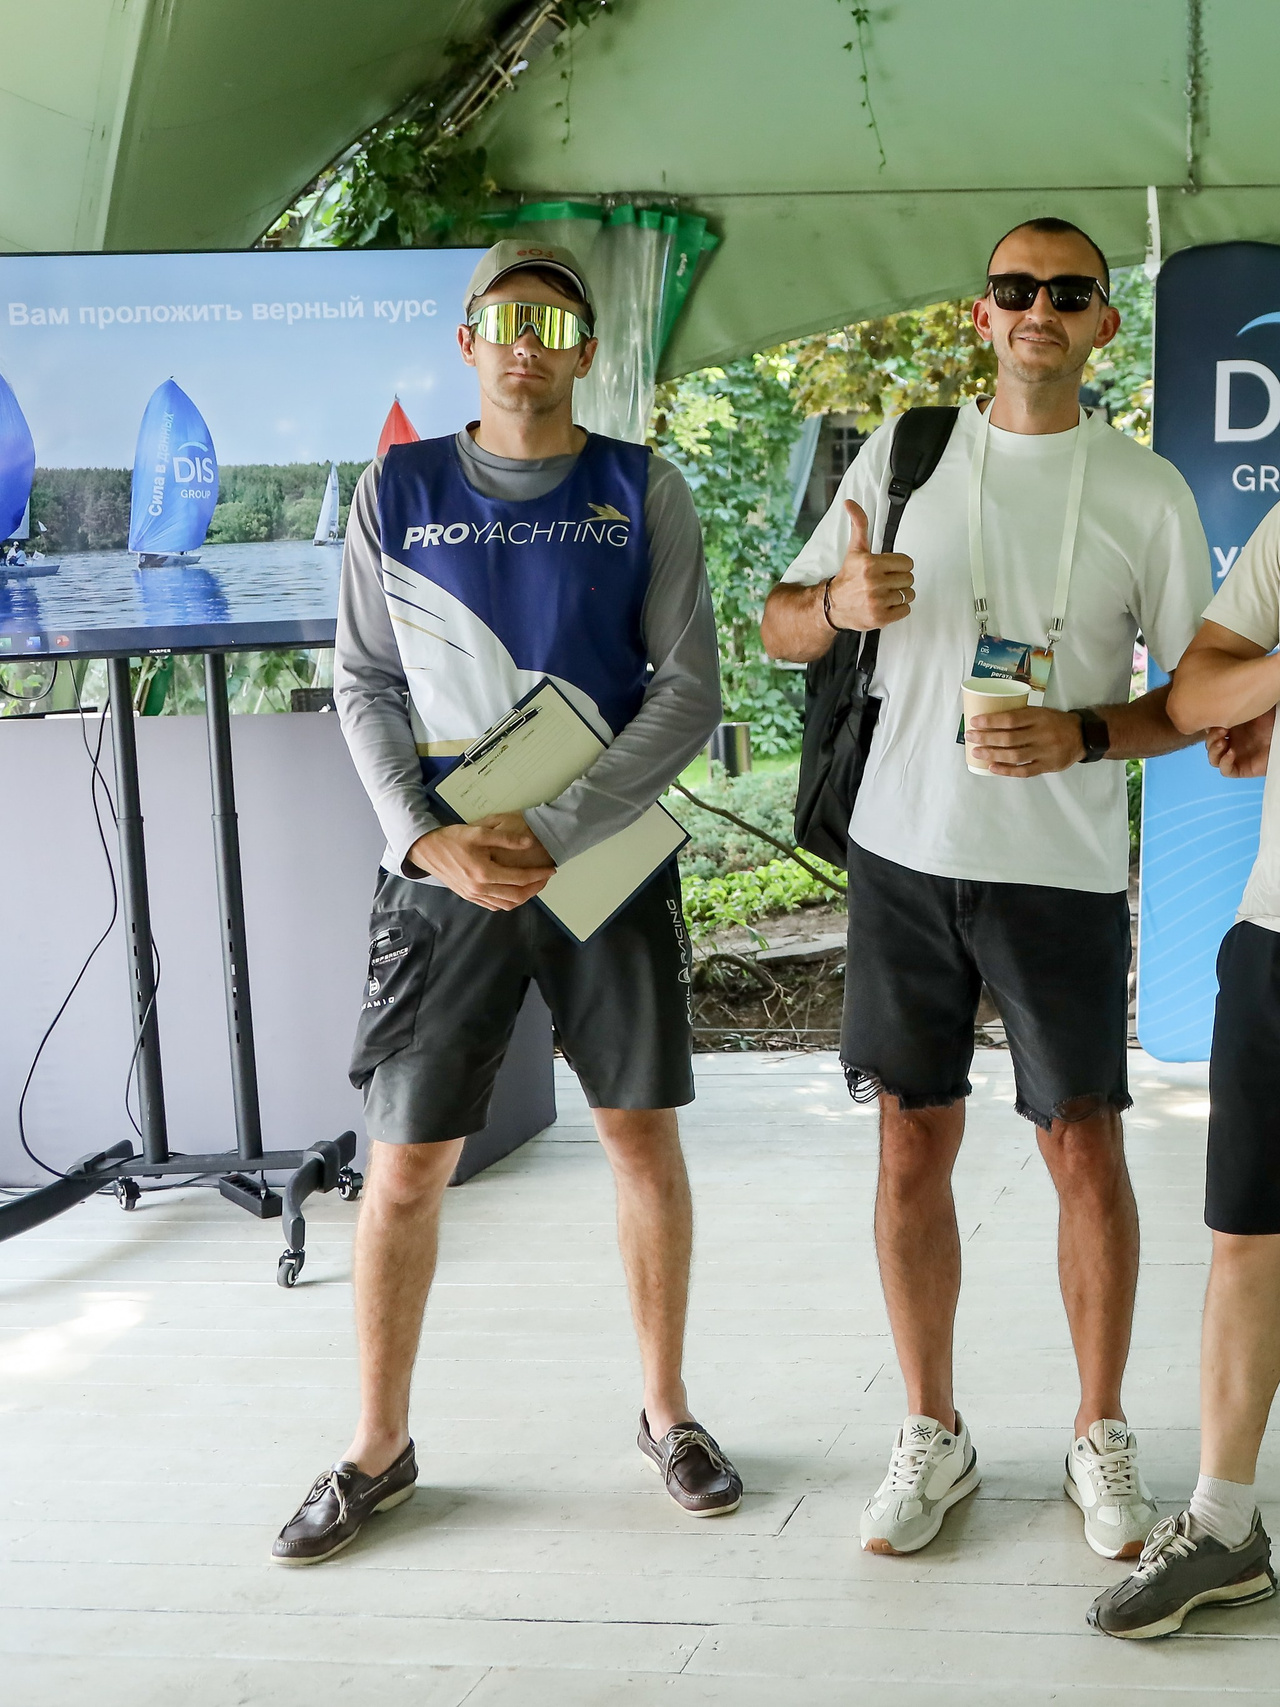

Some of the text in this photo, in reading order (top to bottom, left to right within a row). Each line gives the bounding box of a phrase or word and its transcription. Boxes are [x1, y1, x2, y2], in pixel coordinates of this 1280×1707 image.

[8, 296, 437, 329] Вам проложить верный курс
[172, 456, 215, 484] DIS
[148, 477, 165, 517] Сила
[181, 489, 211, 499] GROUP
[402, 520, 630, 550] PROYACHTING
[978, 660, 1008, 672] Парусная
